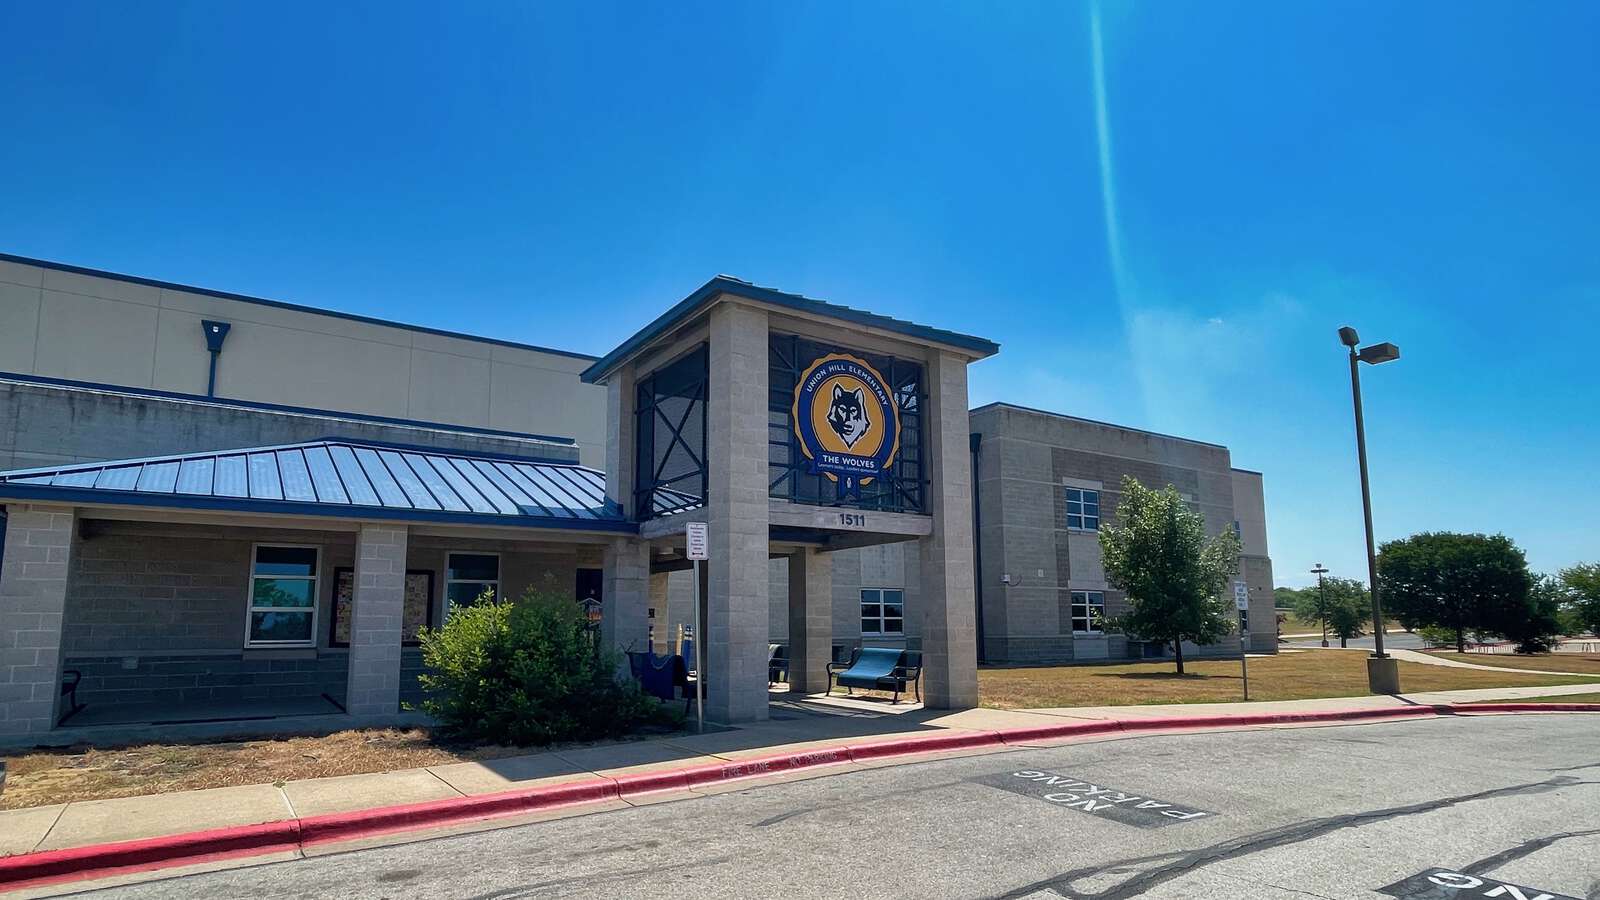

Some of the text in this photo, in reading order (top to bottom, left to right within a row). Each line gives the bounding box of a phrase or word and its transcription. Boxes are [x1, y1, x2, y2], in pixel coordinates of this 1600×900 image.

[806, 364, 889, 406] UNION HILL ELEMENTARY
[822, 454, 840, 464] THE
[841, 457, 875, 469] WOLVES
[839, 513, 865, 527] 1511
[1013, 770, 1206, 819] PARKING
[1044, 792, 1114, 811] NO
